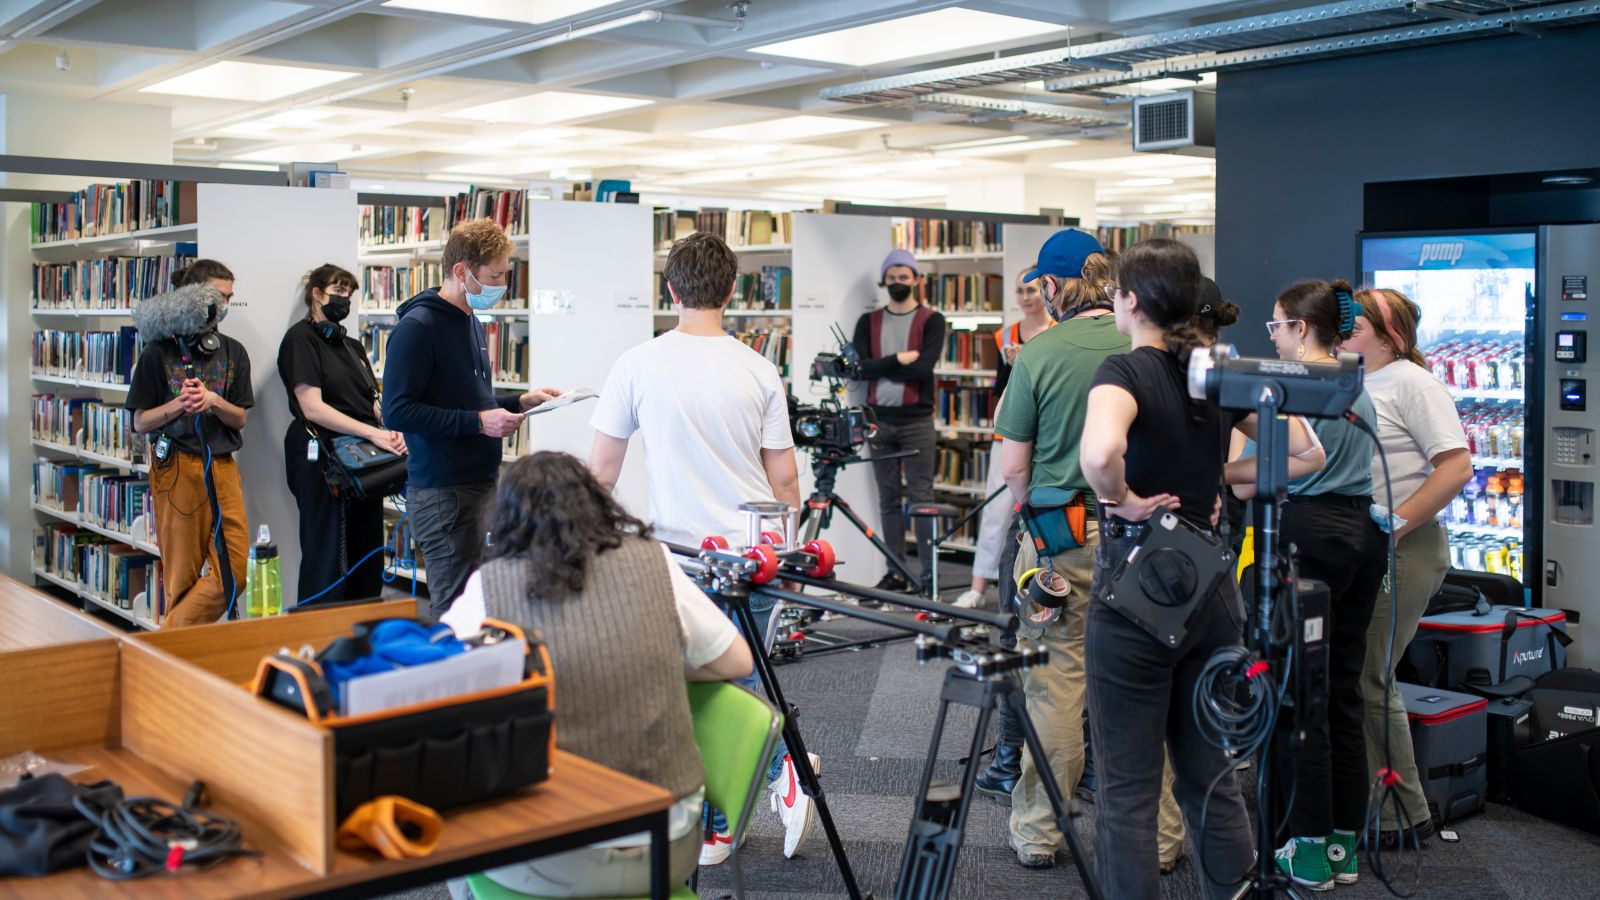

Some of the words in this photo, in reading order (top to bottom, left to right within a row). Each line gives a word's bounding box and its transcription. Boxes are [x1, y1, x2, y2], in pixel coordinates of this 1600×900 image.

[1418, 243, 1464, 266] pump
[1513, 647, 1543, 665] Aputure
[1577, 715, 1595, 723] OVA
